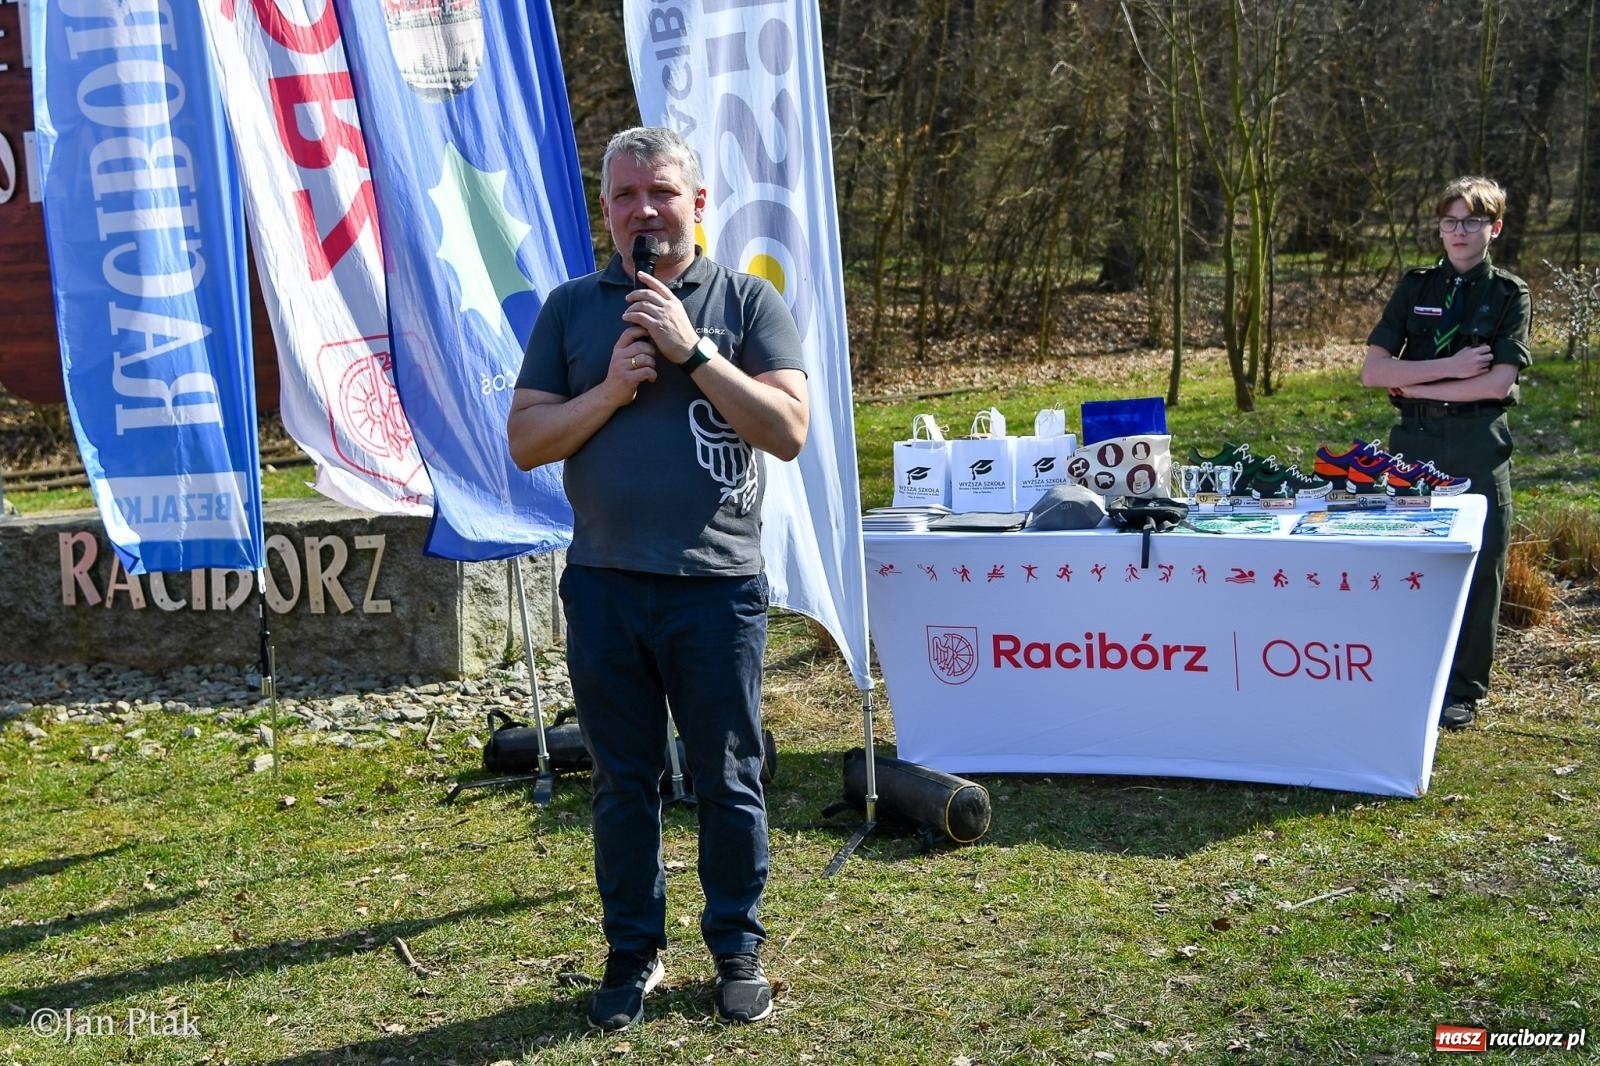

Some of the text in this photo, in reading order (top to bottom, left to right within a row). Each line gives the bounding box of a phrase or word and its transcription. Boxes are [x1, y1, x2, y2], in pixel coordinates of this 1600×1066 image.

[696, 326, 725, 335] CIBÓRZ
[991, 632, 1373, 683] Racibórz OSiR
